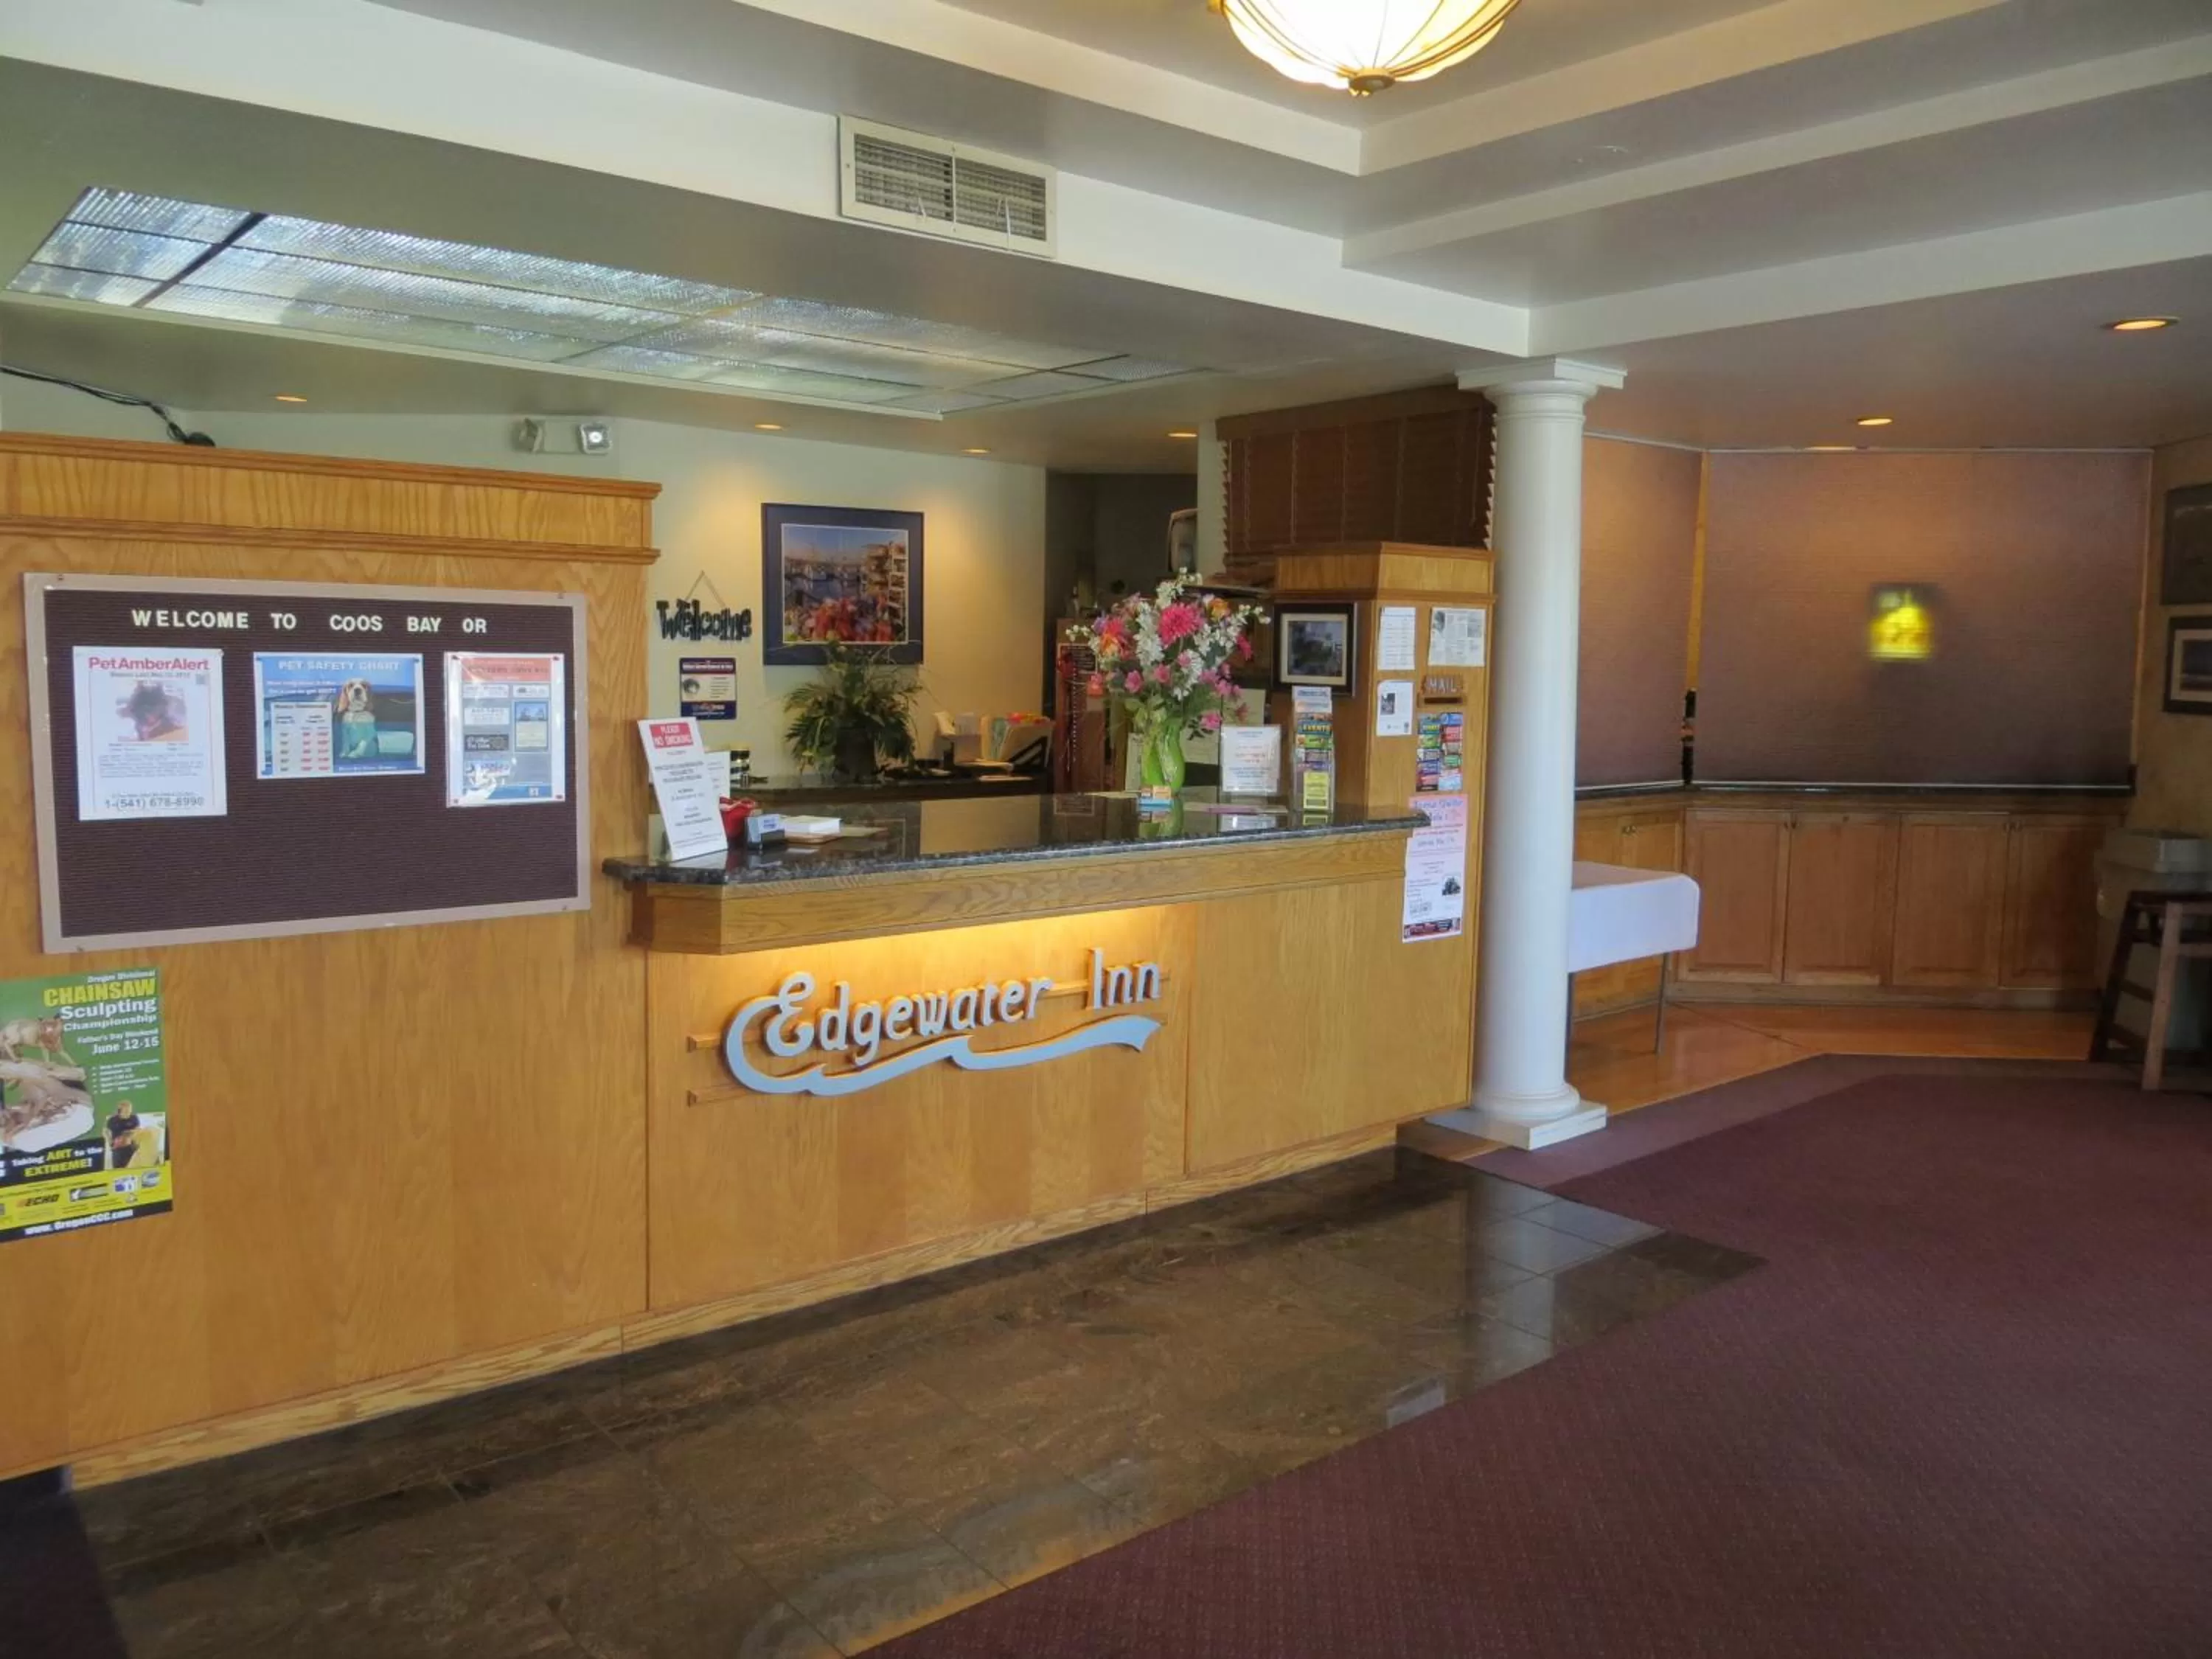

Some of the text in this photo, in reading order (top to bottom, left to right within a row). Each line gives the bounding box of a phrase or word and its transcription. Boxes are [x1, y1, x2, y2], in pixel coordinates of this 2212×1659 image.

[131, 609, 487, 634] WELCOME TO COOS BAY OR
[656, 598, 752, 641] Welcome
[88, 656, 211, 671] PetAmberAlert
[278, 660, 401, 671] PET SAFETY CHART
[1430, 678, 1457, 693] MAIL
[43, 978, 156, 1007] CHAINSAW
[60, 997, 157, 1020] Sculpting
[764, 947, 1162, 1066] Edgewater Inn
[63, 1015, 157, 1032] Championship
[91, 1043, 121, 1056] June
[46, 1148, 73, 1161] ART
[24, 1158, 93, 1178] EXTREME!
[25, 1194, 60, 1207] ECHO
